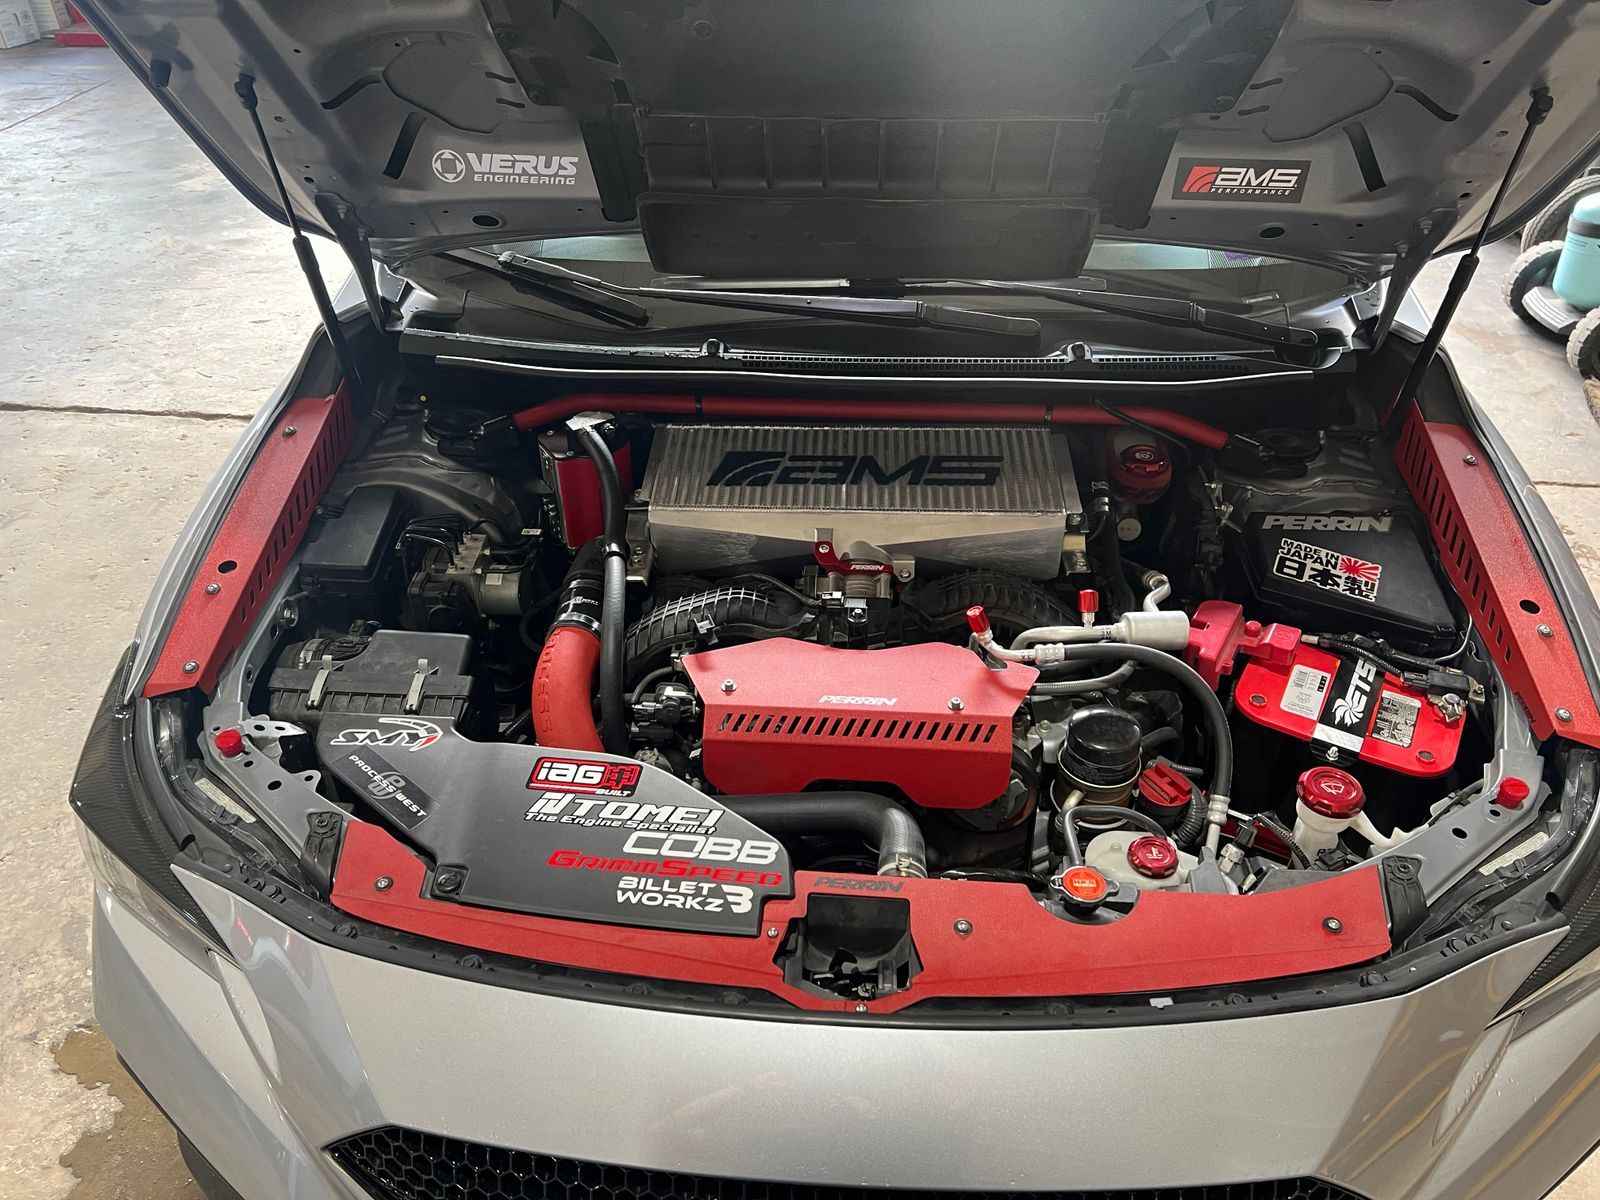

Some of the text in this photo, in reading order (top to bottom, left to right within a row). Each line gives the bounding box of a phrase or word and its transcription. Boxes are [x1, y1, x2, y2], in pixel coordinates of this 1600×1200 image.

[466, 153, 579, 176] VERUS
[474, 174, 576, 185] ENGINEERING
[1214, 167, 1302, 188] AMS
[1261, 515, 1394, 533] PERRIN
[1279, 547, 1338, 571] JAPAN
[1282, 539, 1340, 563] MADE IN
[850, 563, 885, 571] PERRIN
[1274, 555, 1377, 600] 日本製
[1344, 656, 1377, 714] ETS
[817, 694, 898, 706] PERRIN
[348, 754, 428, 818] PROCESS WEST
[595, 788, 632, 797] BUILT
[524, 812, 717, 835] The Engine Specialist
[573, 798, 726, 827] TOMEI
[622, 830, 780, 865] COBB
[617, 875, 718, 896] BILLET
[813, 876, 905, 892] PERRIN
[615, 889, 724, 912] WORKZ
